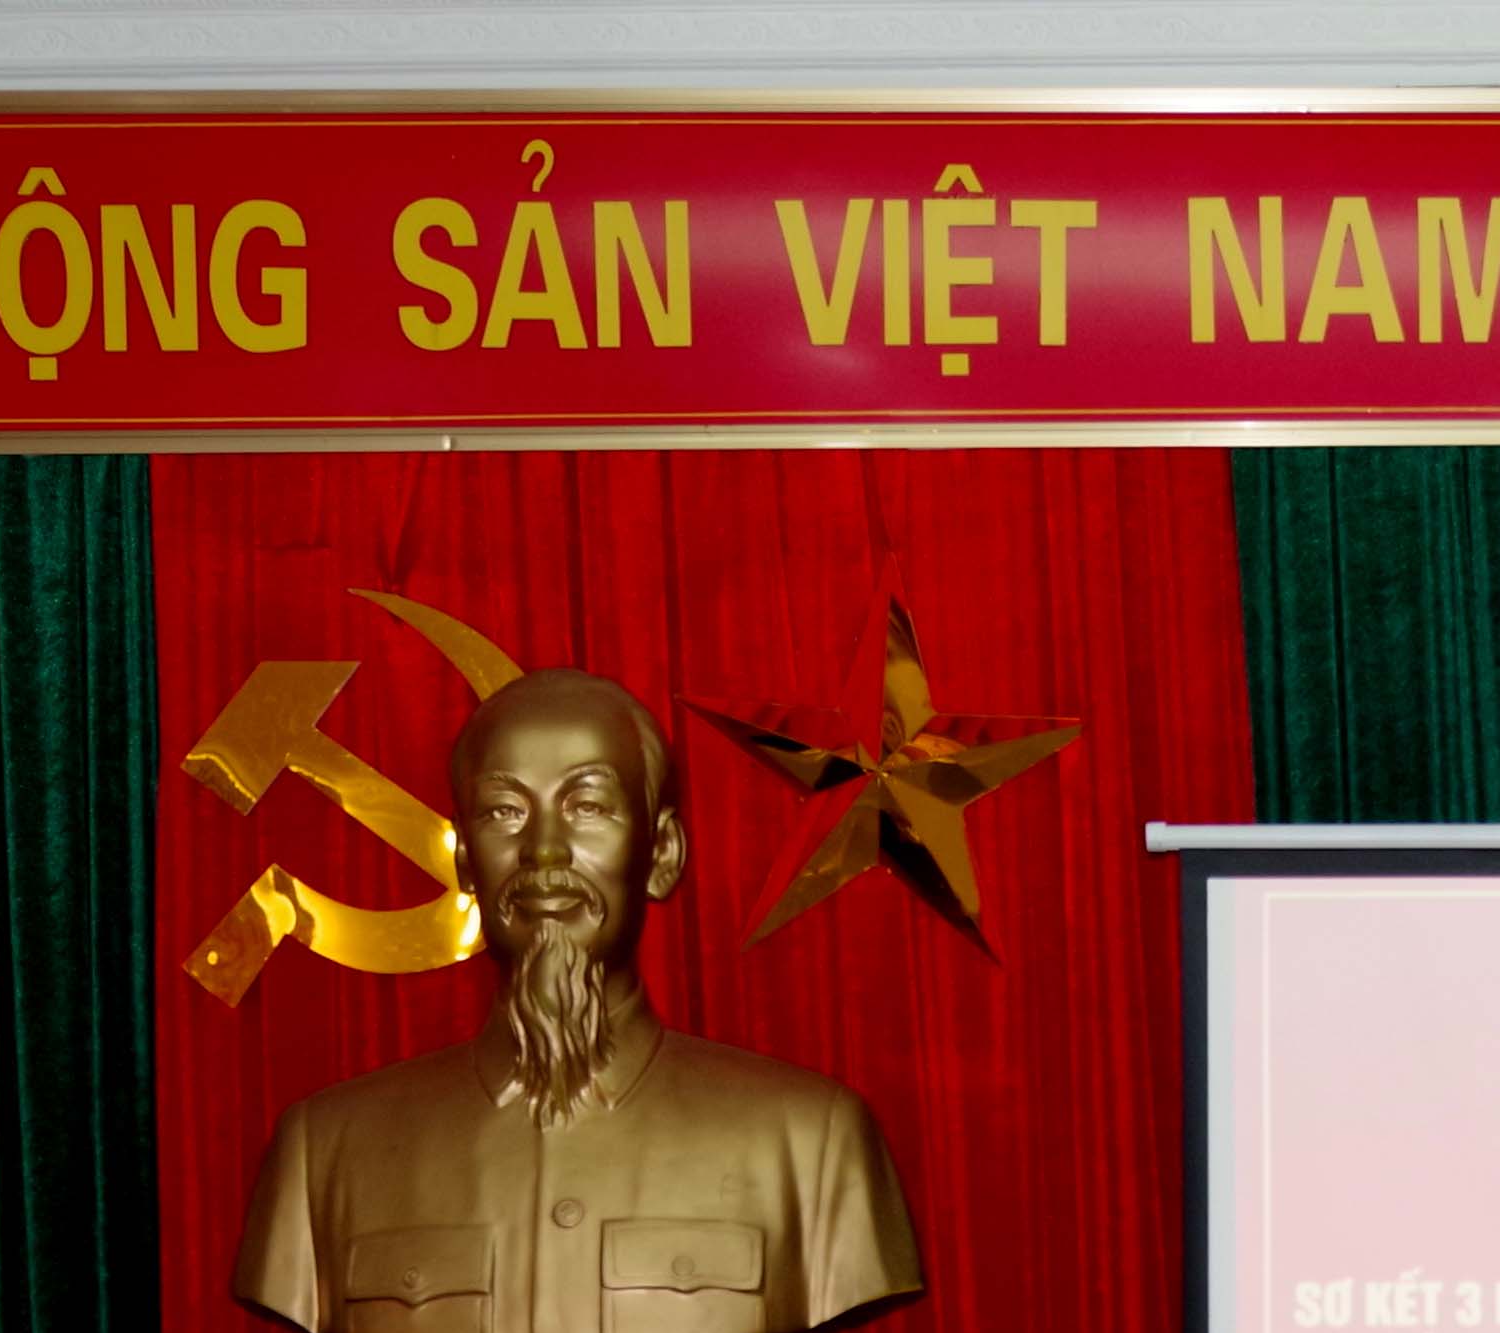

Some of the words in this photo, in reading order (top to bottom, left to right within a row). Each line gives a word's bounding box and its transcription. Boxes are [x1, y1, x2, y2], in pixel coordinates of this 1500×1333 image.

[395, 140, 693, 350] SẢN
[776, 165, 1096, 375] VIỆT
[1294, 1279, 1355, 1327] SƠ
[1365, 1268, 1443, 1327] KẾT
[1455, 1281, 1483, 1326] 3
